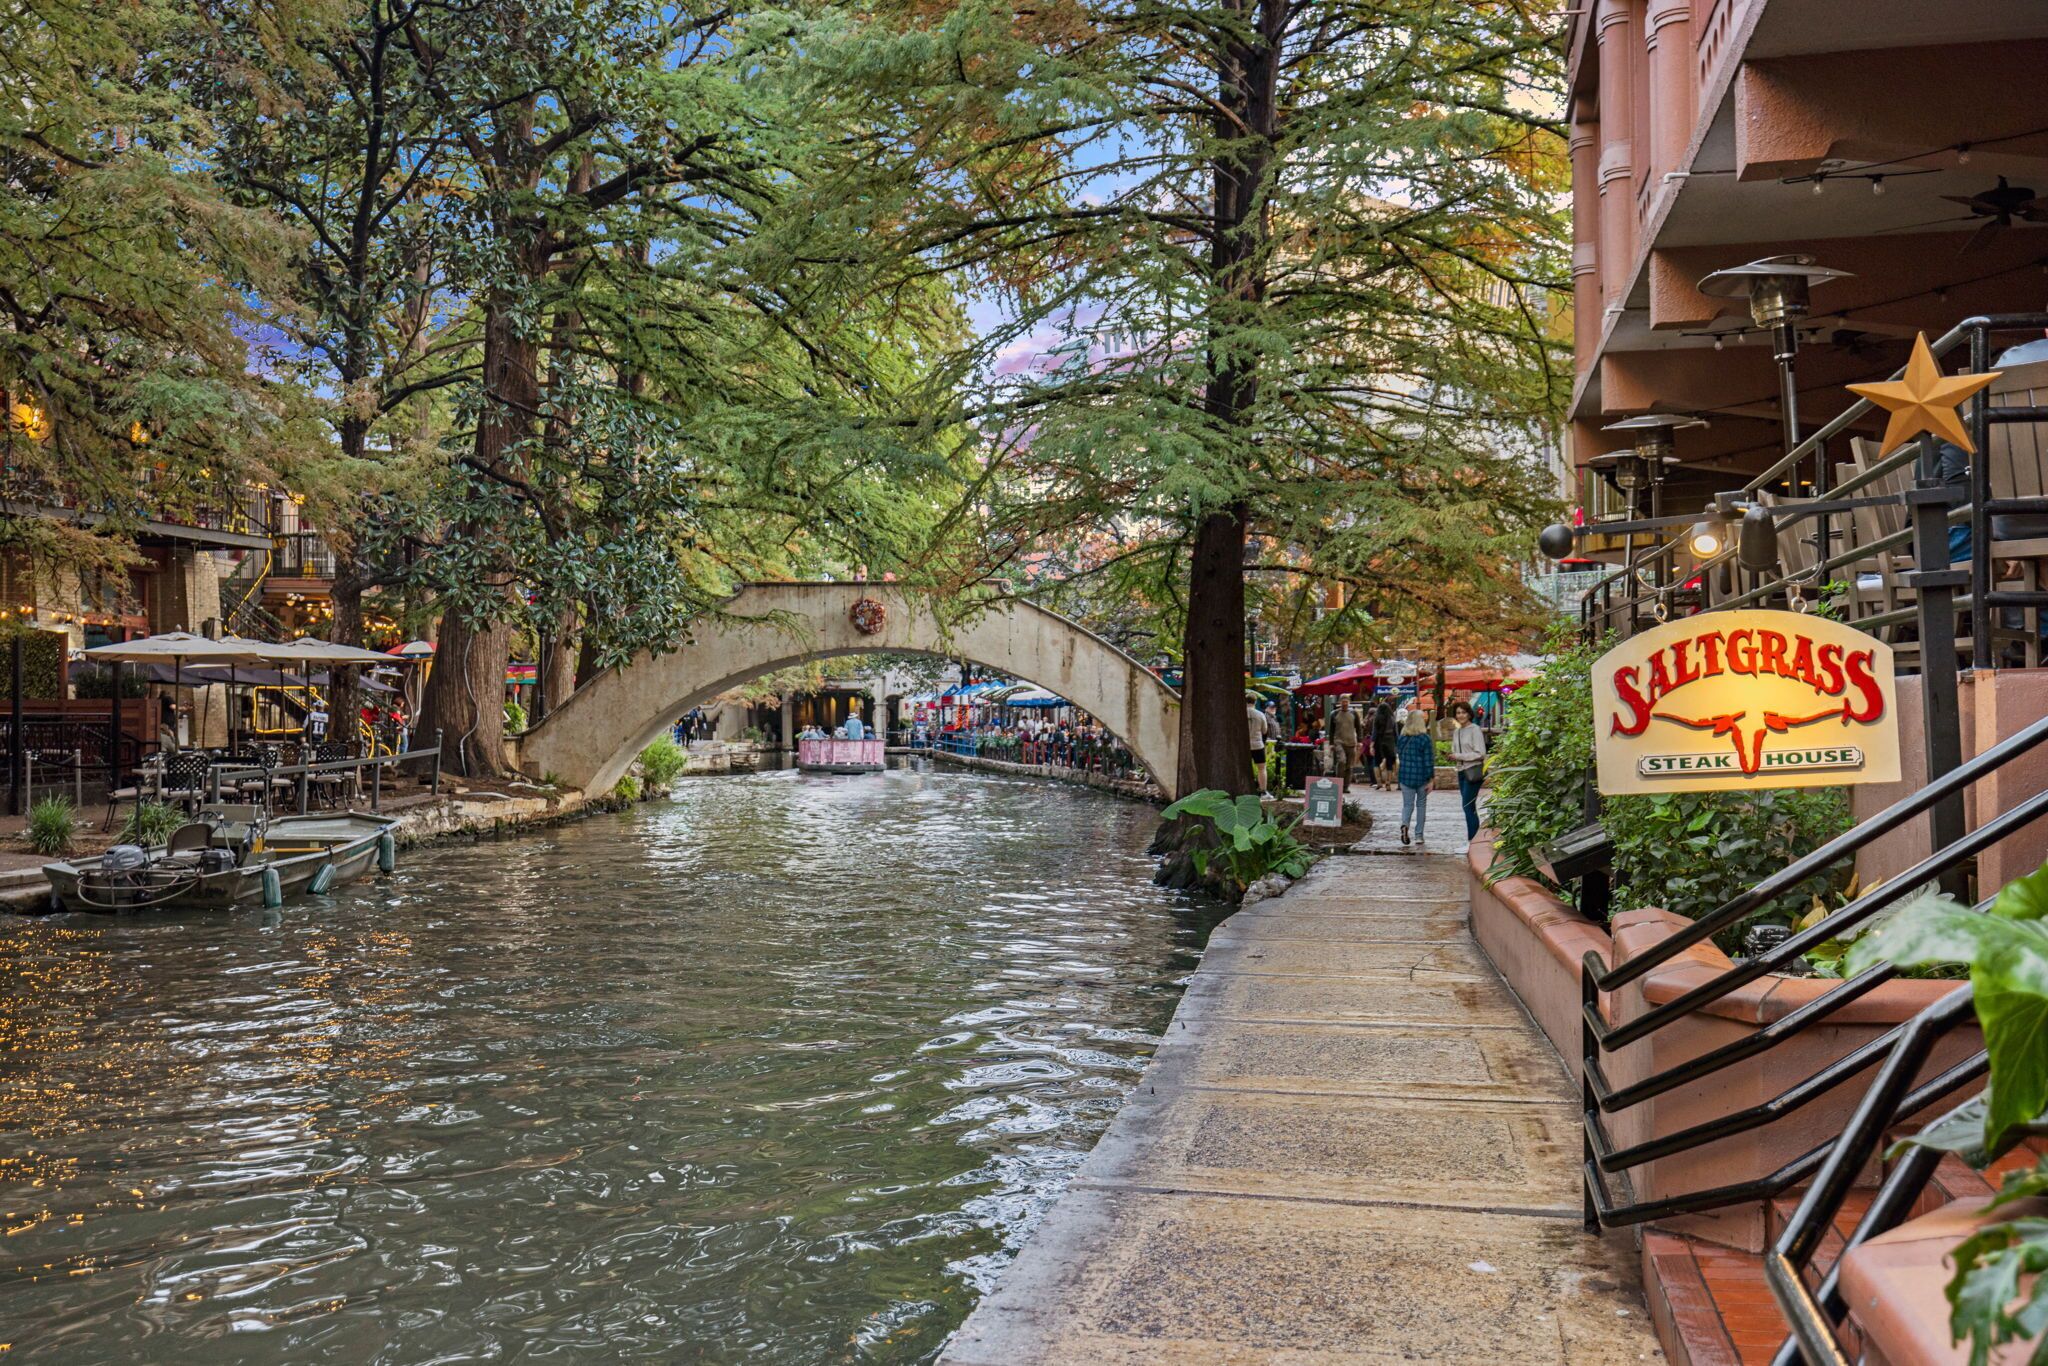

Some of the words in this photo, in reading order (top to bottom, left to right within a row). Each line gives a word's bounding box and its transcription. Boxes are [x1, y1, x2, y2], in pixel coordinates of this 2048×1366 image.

[1610, 628, 1884, 737] SALTGRASS
[1649, 755, 1732, 770] STEAK
[1766, 749, 1854, 766] HOUSE
